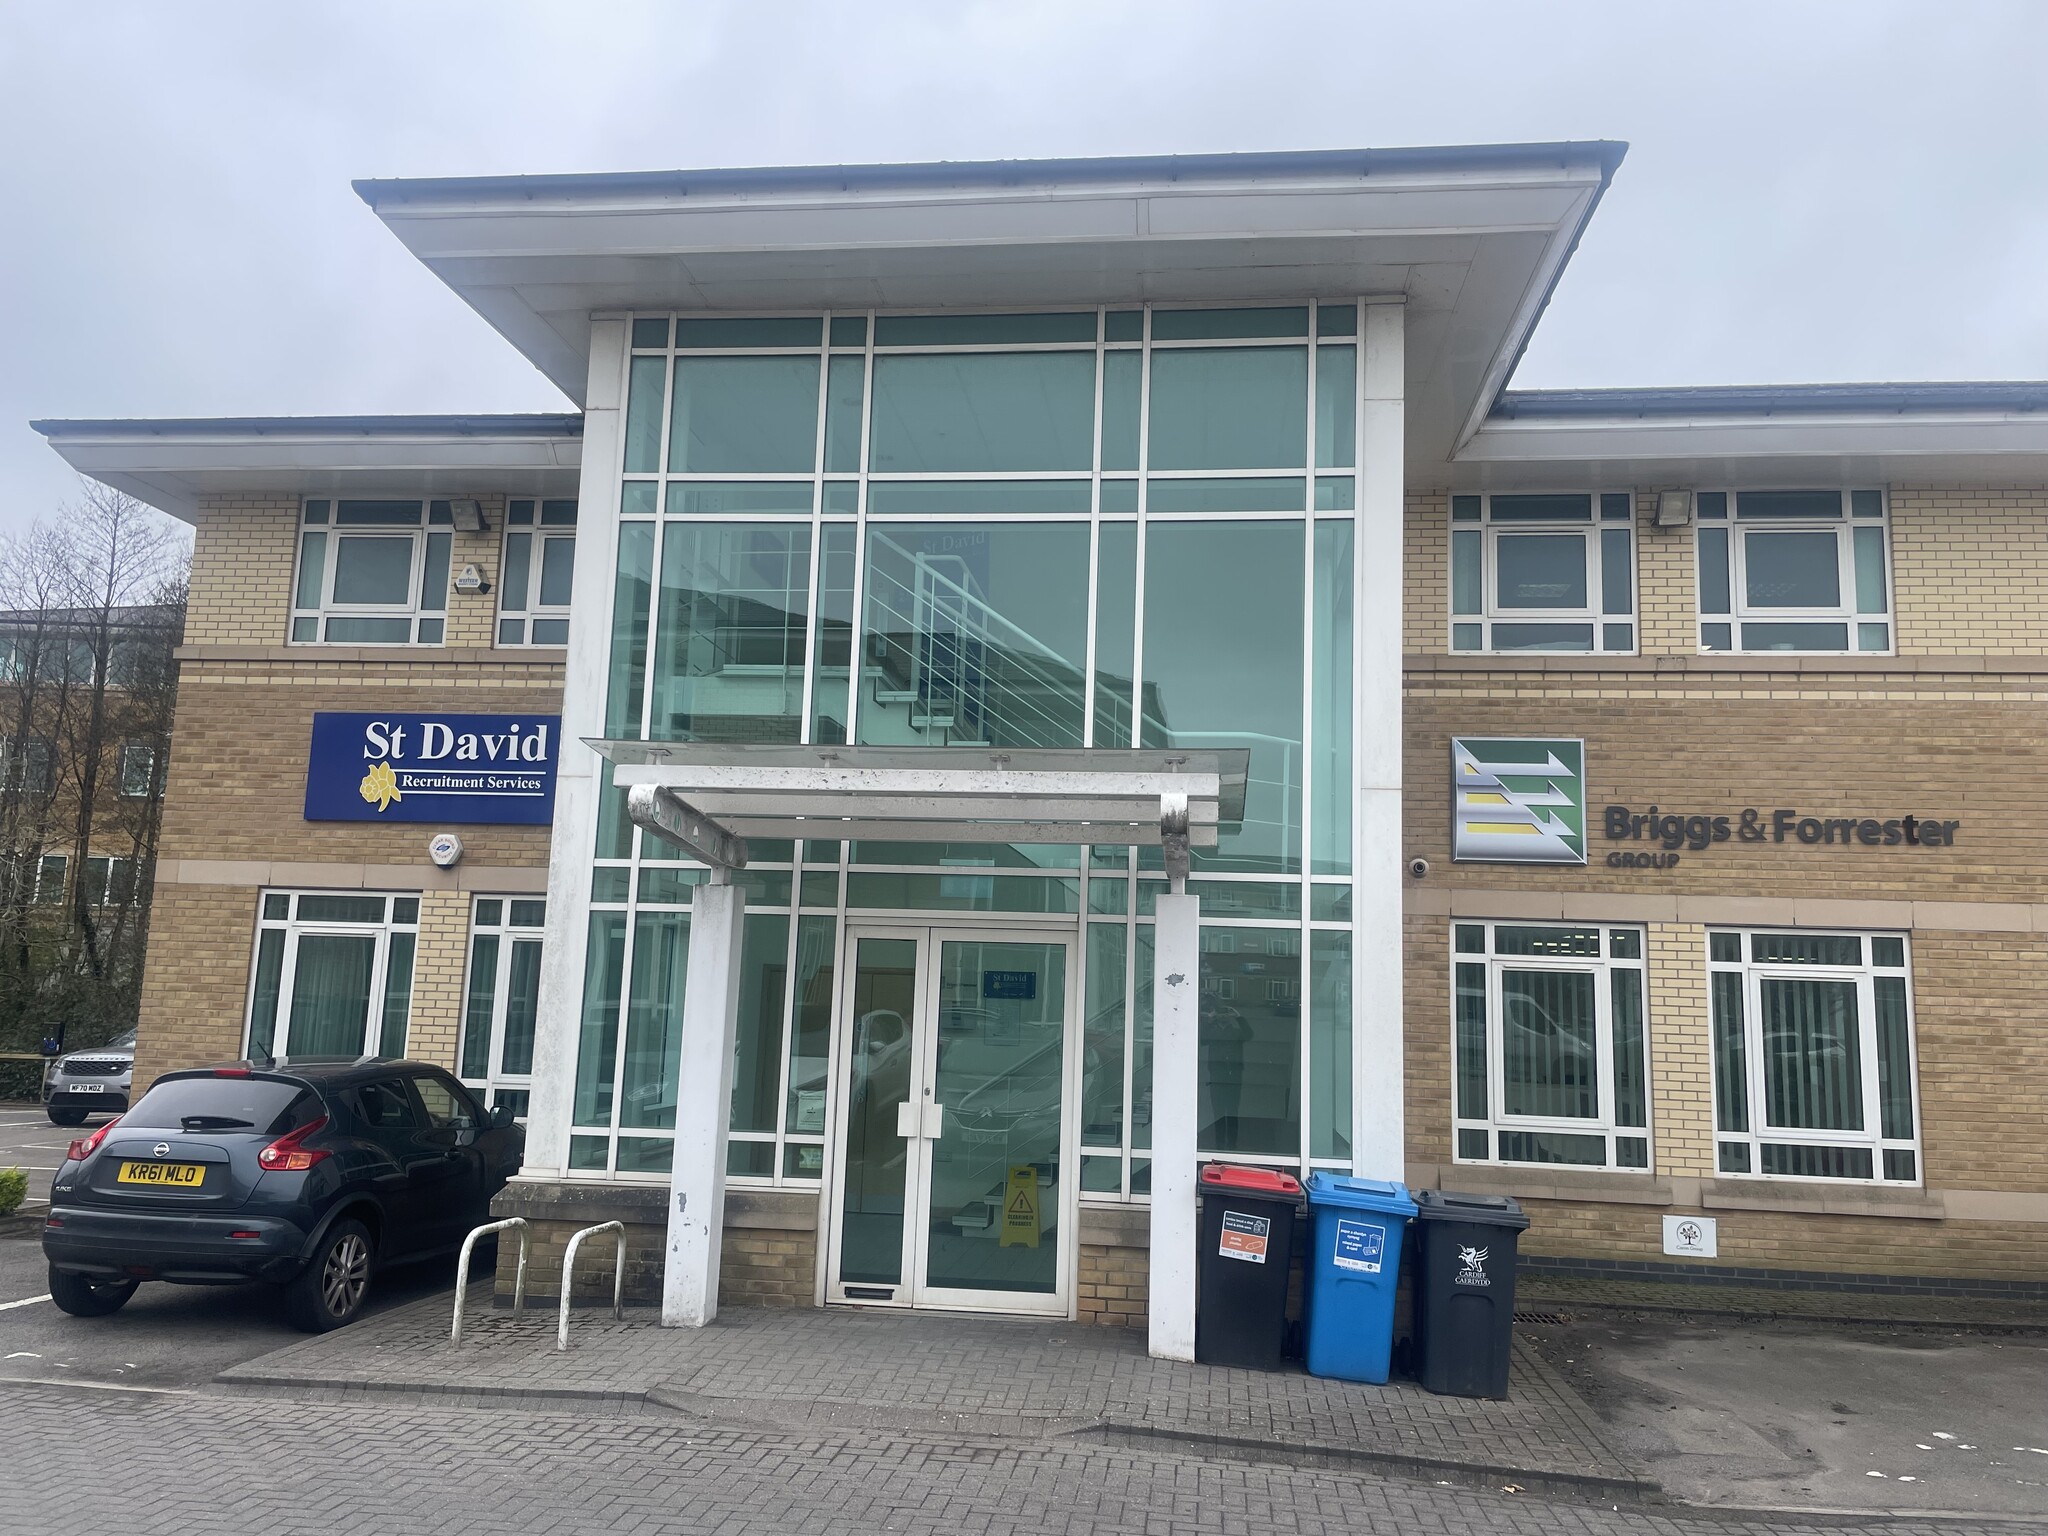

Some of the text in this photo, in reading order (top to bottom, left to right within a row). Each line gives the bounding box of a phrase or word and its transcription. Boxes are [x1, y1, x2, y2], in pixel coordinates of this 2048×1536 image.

[363, 721, 548, 761] St David
[402, 774, 541, 789] Recruitment Services
[1605, 805, 1960, 850] Briggs & Forrester
[1607, 851, 1681, 869] GROUP
[992, 974, 1027, 982] St David
[128, 1164, 196, 1182] KR61 MLO
